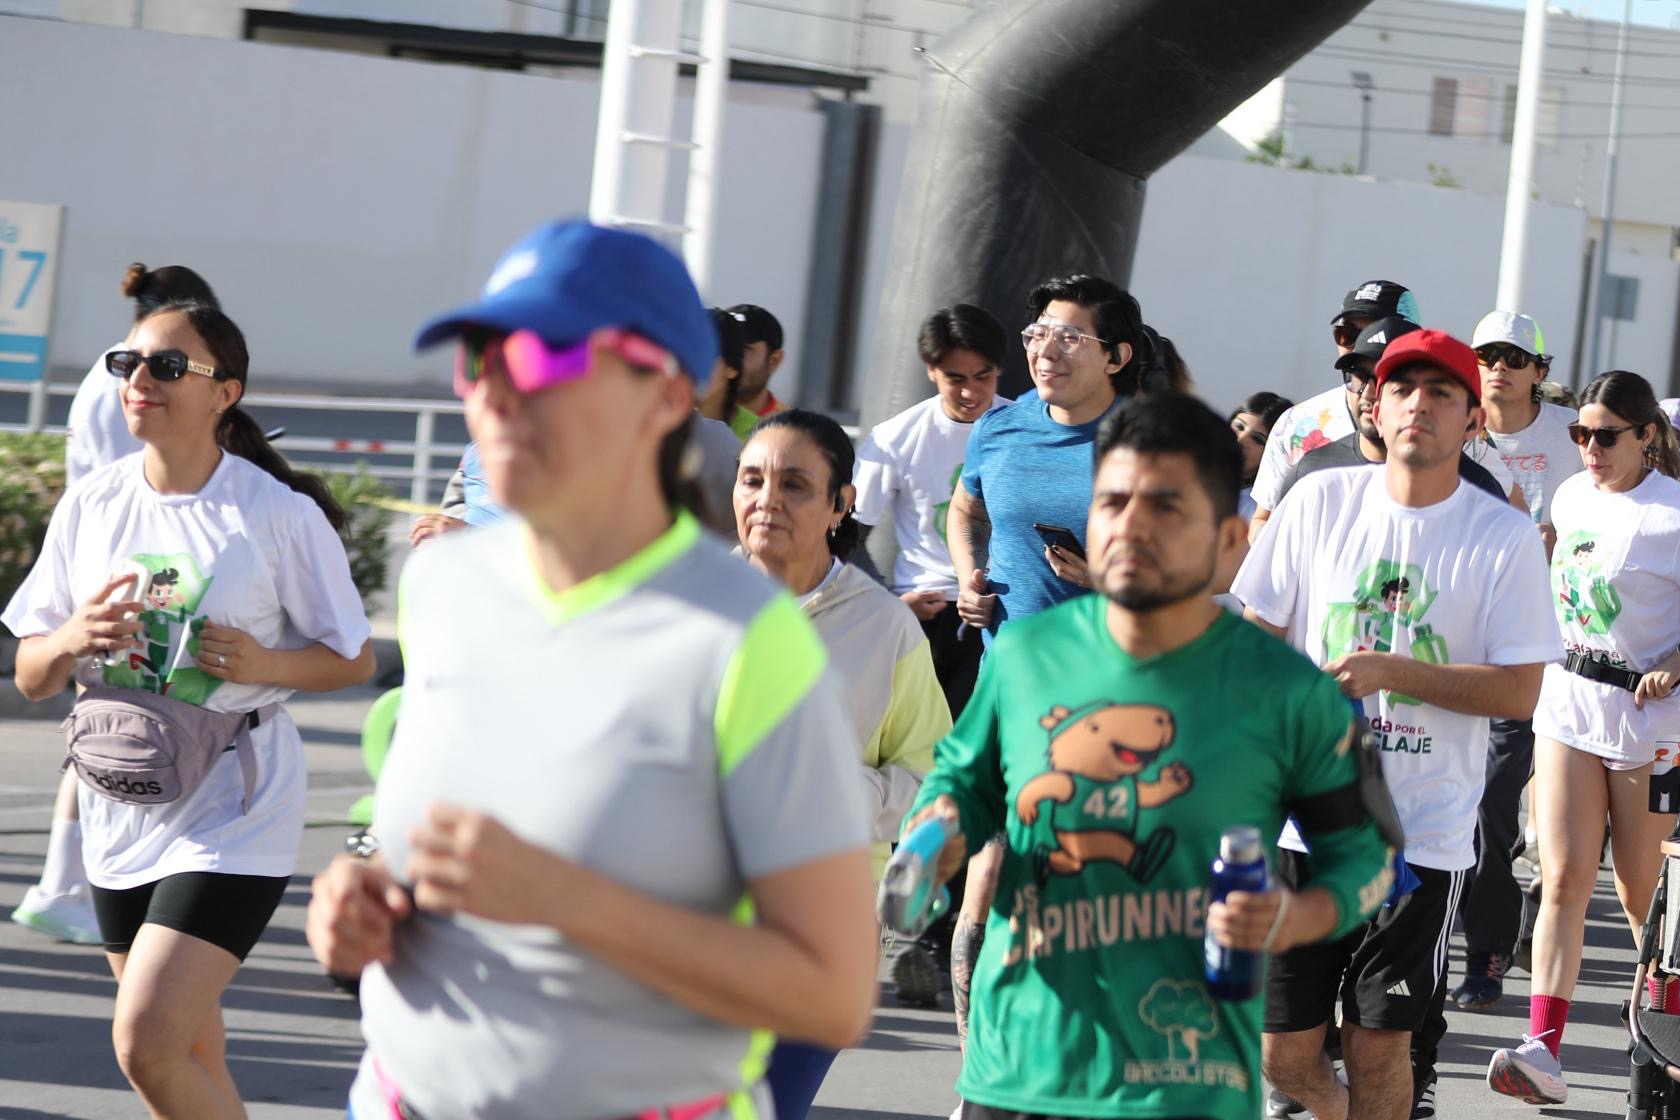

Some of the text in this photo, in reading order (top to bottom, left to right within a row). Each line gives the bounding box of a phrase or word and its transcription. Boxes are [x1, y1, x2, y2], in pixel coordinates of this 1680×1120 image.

[1395, 724, 1416, 735] POR
[1417, 727, 1426, 735] EL
[1083, 785, 1129, 819] 42
